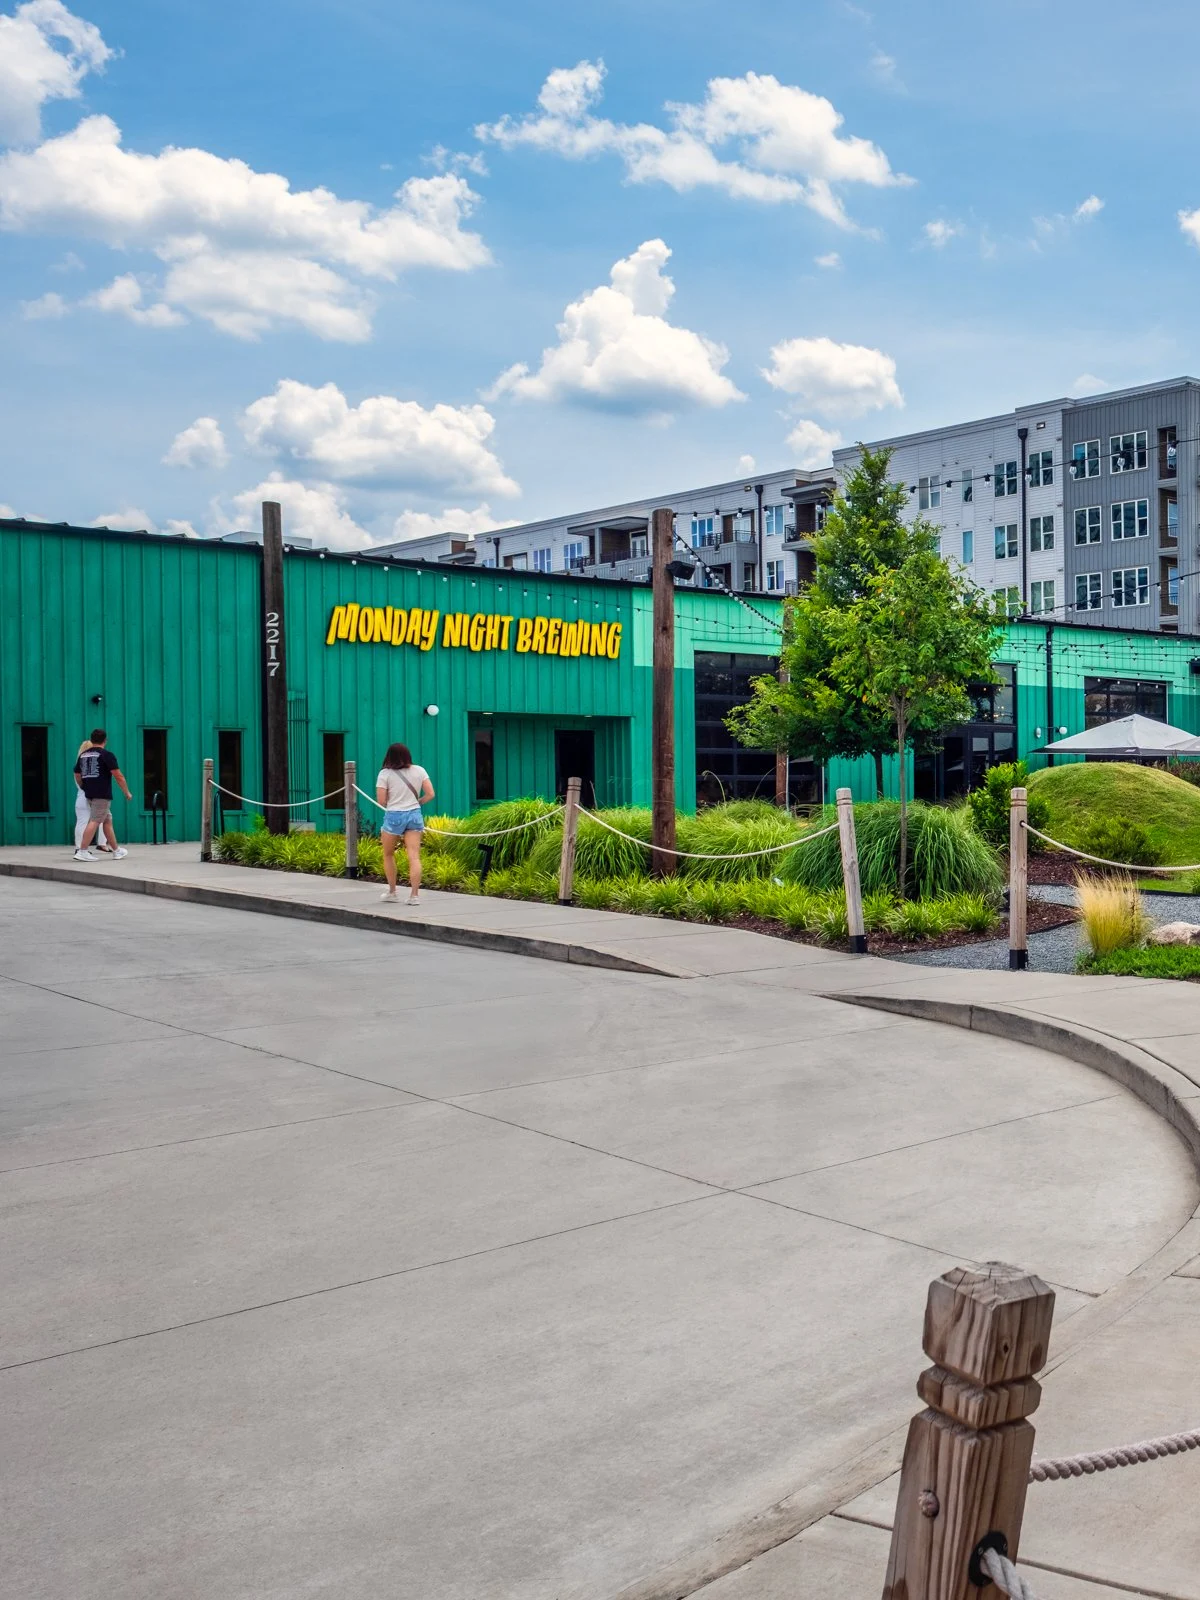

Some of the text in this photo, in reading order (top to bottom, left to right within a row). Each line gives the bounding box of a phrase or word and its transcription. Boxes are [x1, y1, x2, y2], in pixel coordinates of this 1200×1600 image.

[265, 612, 281, 677] 2217
[326, 603, 623, 660] MONDAY NIGHT BREWING
